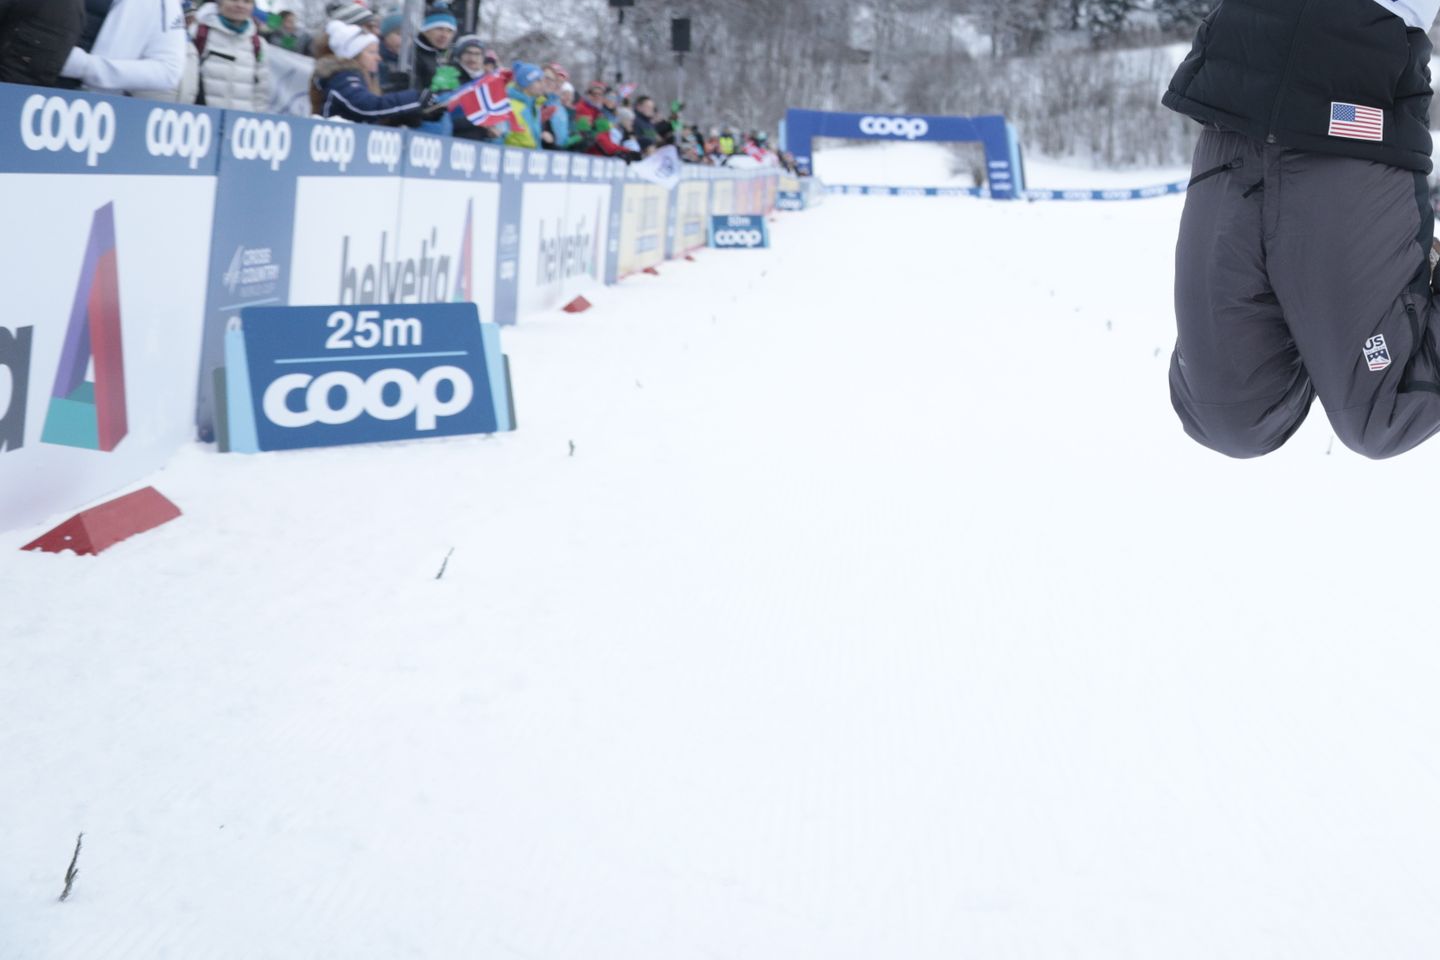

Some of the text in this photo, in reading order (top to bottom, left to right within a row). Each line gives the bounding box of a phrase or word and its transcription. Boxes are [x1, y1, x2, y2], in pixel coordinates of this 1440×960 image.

[20, 94, 116, 166] coop
[146, 107, 211, 169] coop
[231, 117, 291, 170] coop
[310, 124, 355, 171] coop
[859, 116, 928, 140] coop
[715, 229, 761, 247] coop
[341, 226, 450, 304] helvetia
[325, 310, 422, 350] 25m
[262, 365, 474, 431] coop
